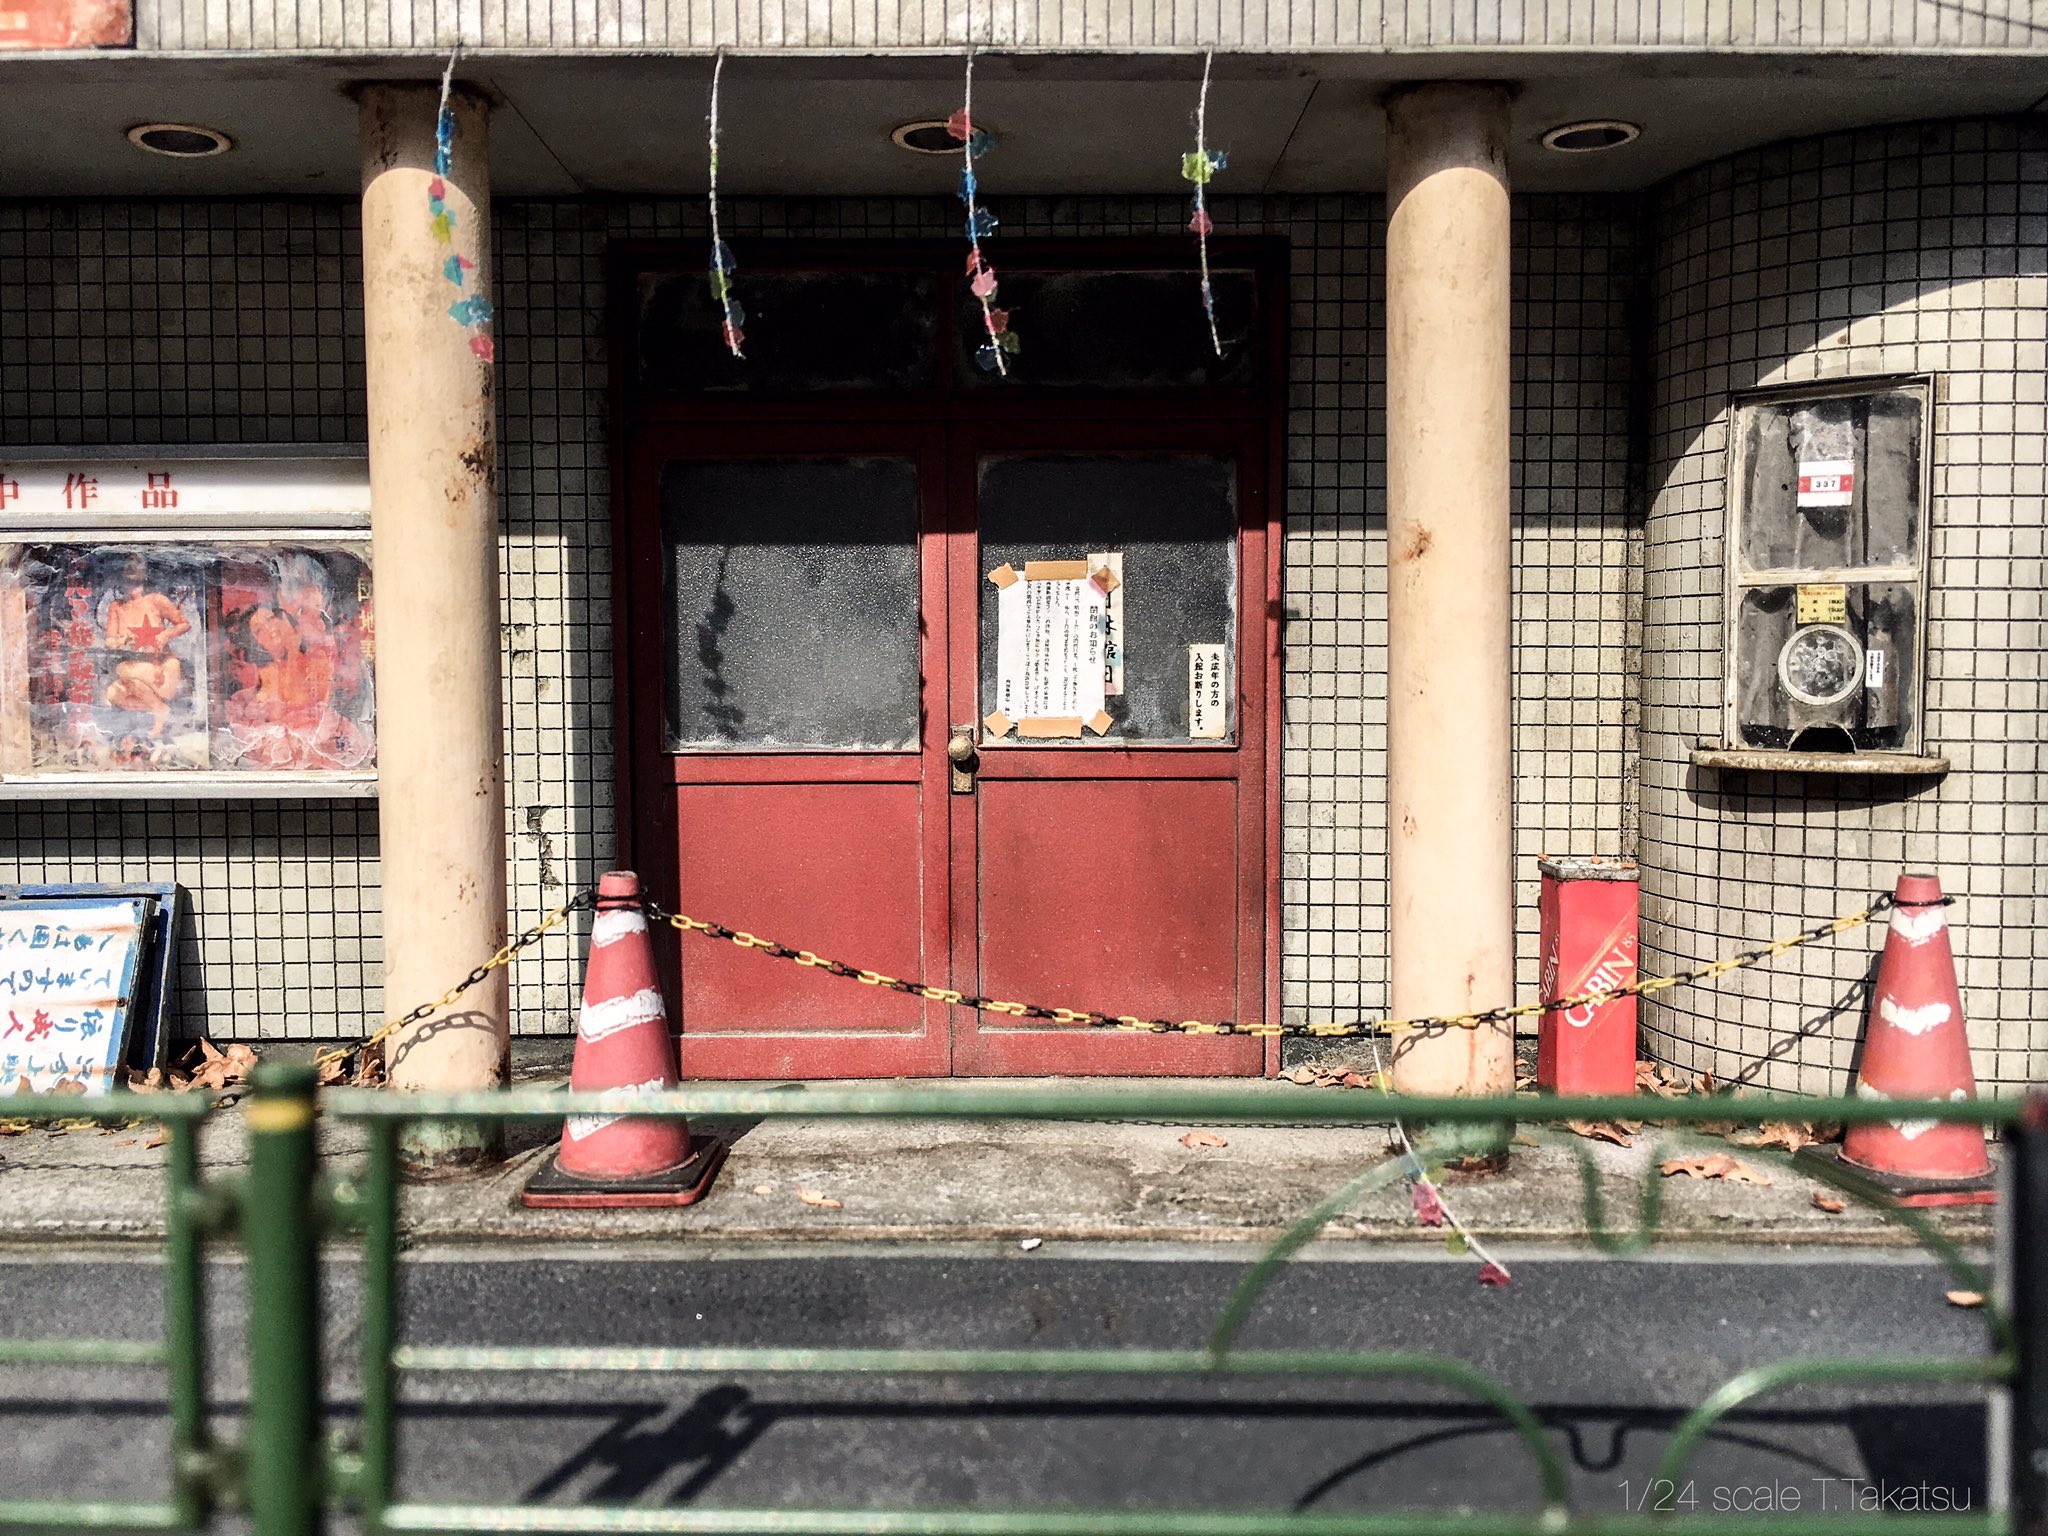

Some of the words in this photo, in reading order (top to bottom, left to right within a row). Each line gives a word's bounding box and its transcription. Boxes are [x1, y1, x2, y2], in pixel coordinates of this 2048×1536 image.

[1211, 652, 1220, 707] 未成年の方の
[1564, 946, 1634, 1027] CABIN
[1621, 931, 1637, 948] 85
